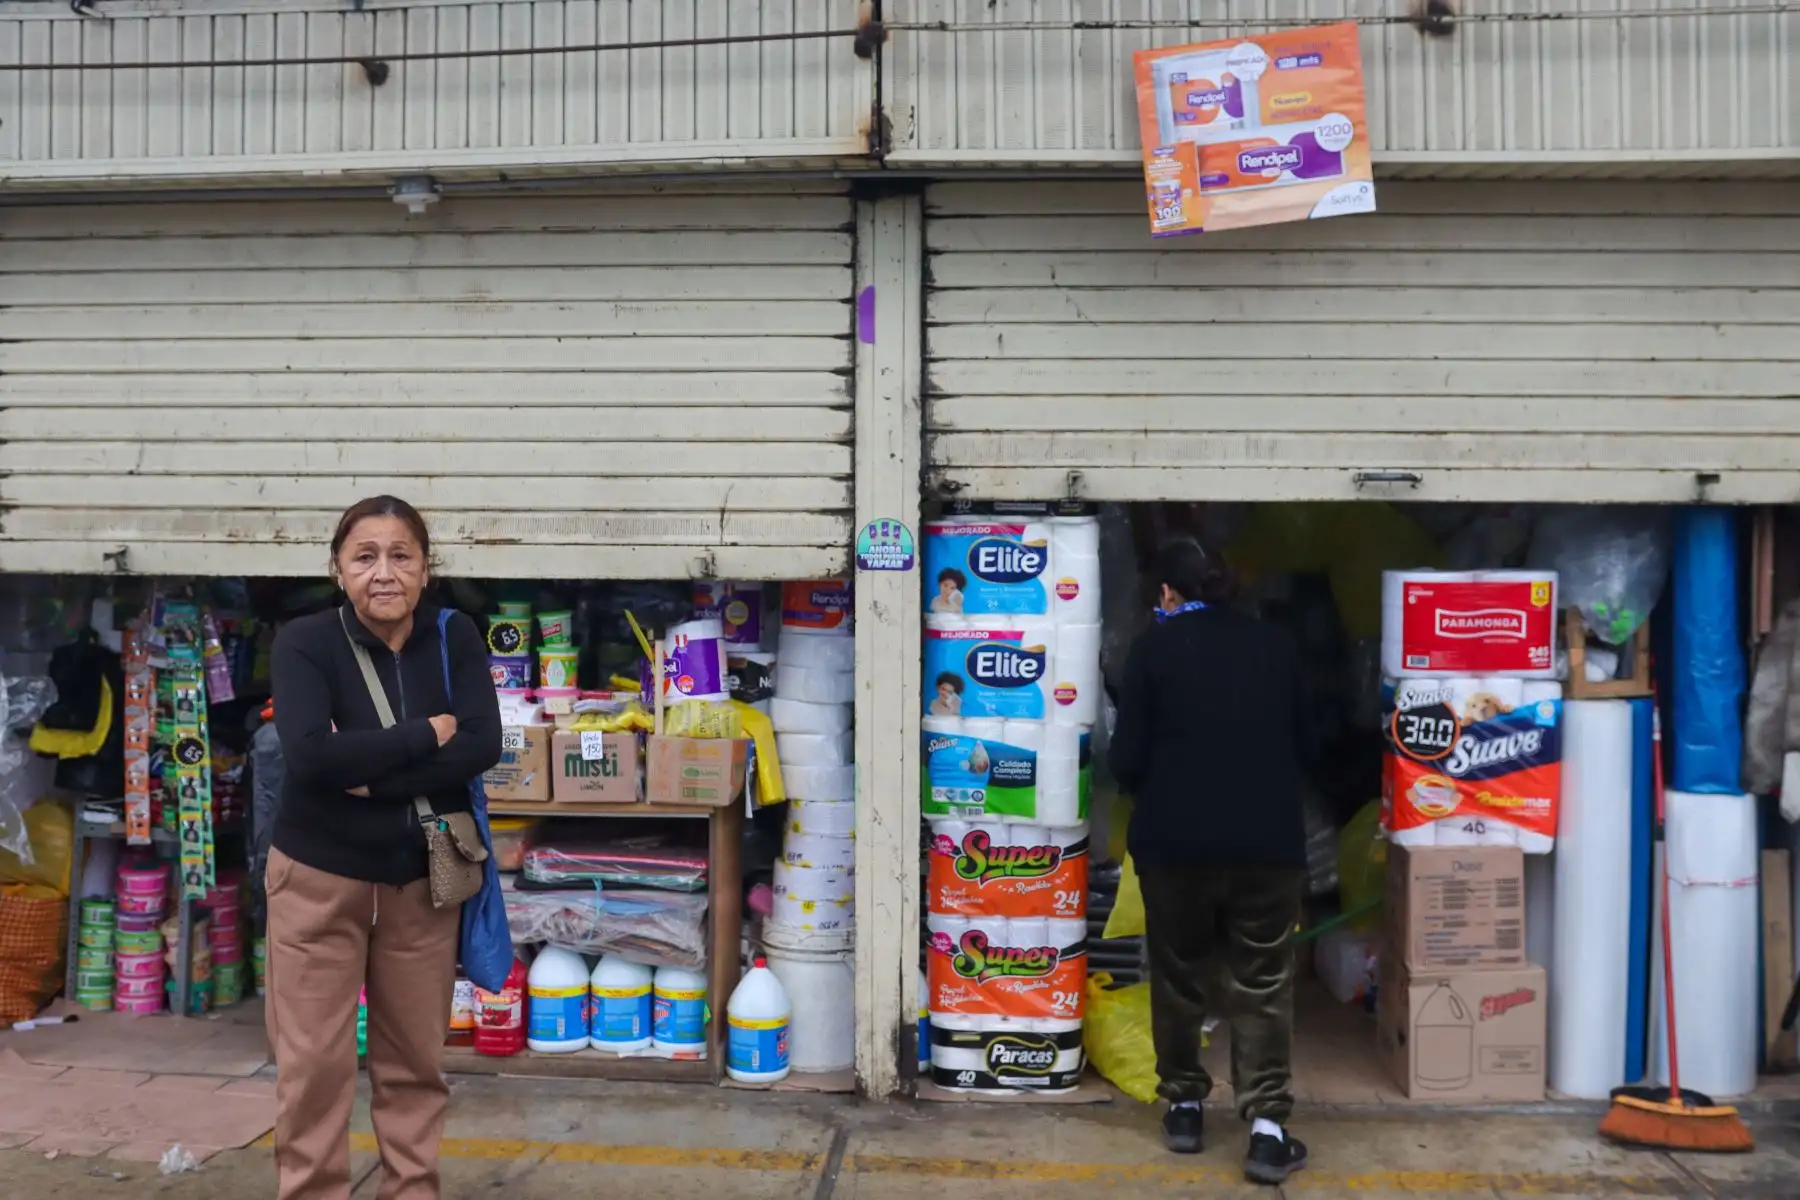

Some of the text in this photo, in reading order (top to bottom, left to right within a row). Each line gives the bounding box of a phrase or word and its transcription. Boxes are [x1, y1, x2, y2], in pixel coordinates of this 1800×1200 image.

[1318, 122, 1350, 137] 1200
[1242, 148, 1299, 168] Rendipel
[941, 527, 991, 535] MEJORADO
[868, 545, 902, 554] AHORA
[977, 546, 1040, 574] Elite
[1442, 617, 1520, 629] PARAMONGA
[940, 631, 990, 639] MEJORADO
[976, 651, 1038, 678] Elite
[1400, 688, 1454, 711] Suave
[1446, 730, 1540, 777] Suave
[993, 767, 1032, 776] Completo
[998, 760, 1032, 768] Cuidado
[1463, 822, 1486, 834] 40
[954, 829, 1063, 881] Super
[1052, 889, 1080, 909] 24
[952, 929, 1060, 979] Super
[1051, 991, 1079, 1010] 24
[991, 1043, 1054, 1063] Paracas
[956, 1071, 977, 1083] 40
